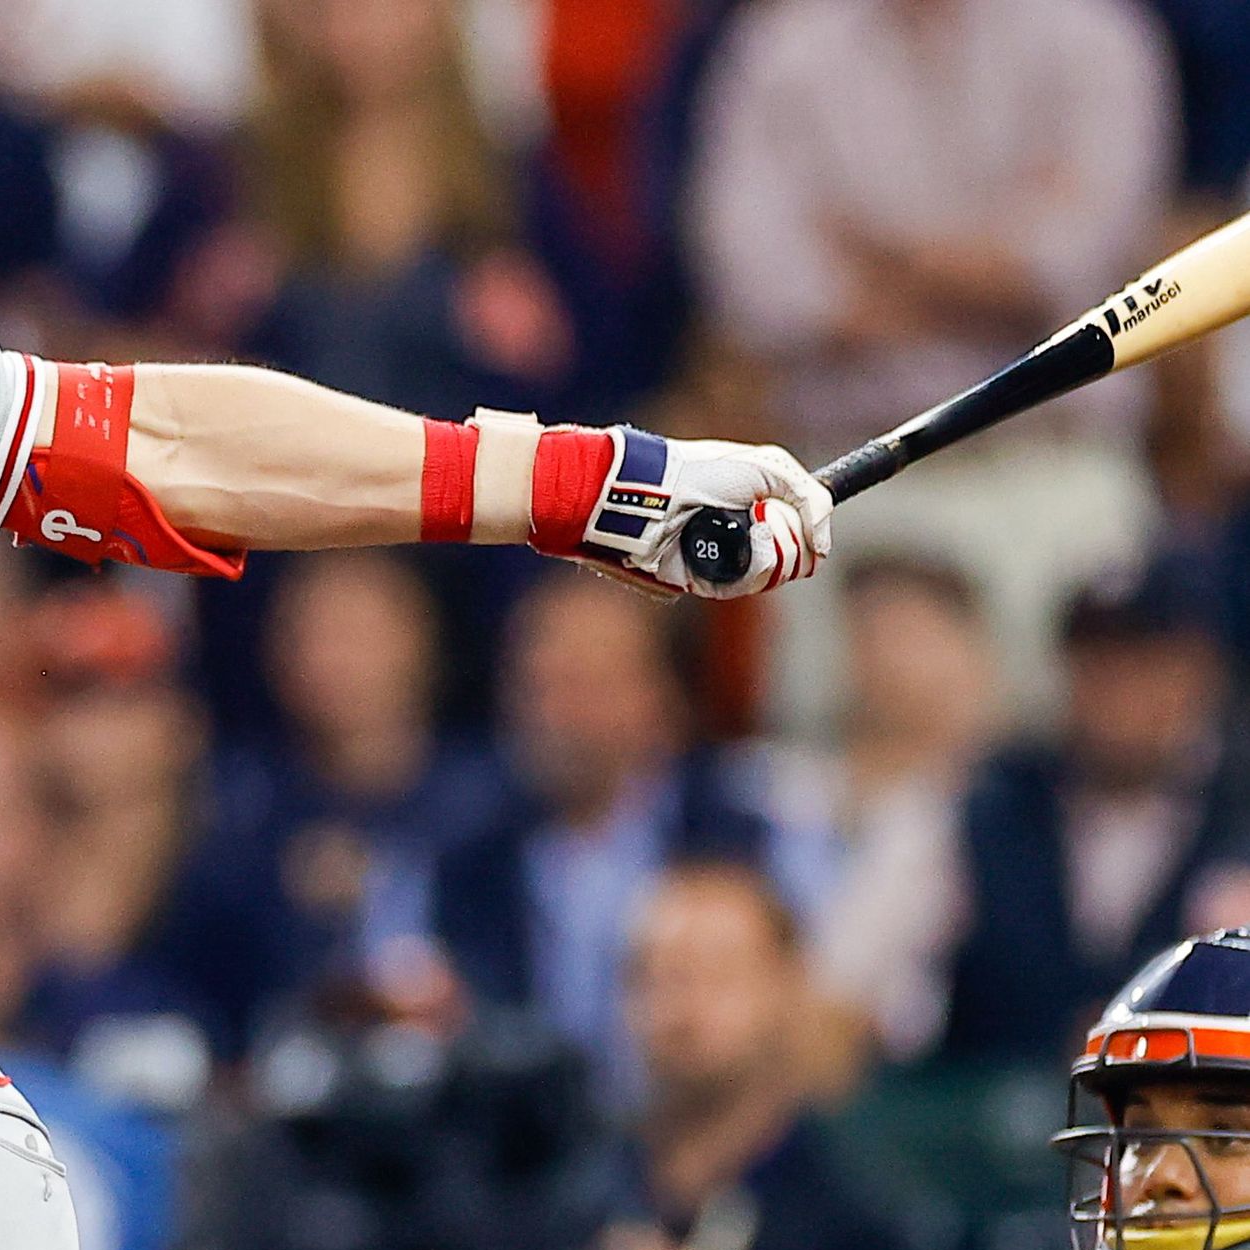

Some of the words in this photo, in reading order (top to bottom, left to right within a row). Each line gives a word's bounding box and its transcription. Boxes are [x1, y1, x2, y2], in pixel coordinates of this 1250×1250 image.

[1123, 282, 1182, 332] marucci
[41, 509, 102, 541] P
[696, 540, 719, 559] 28
